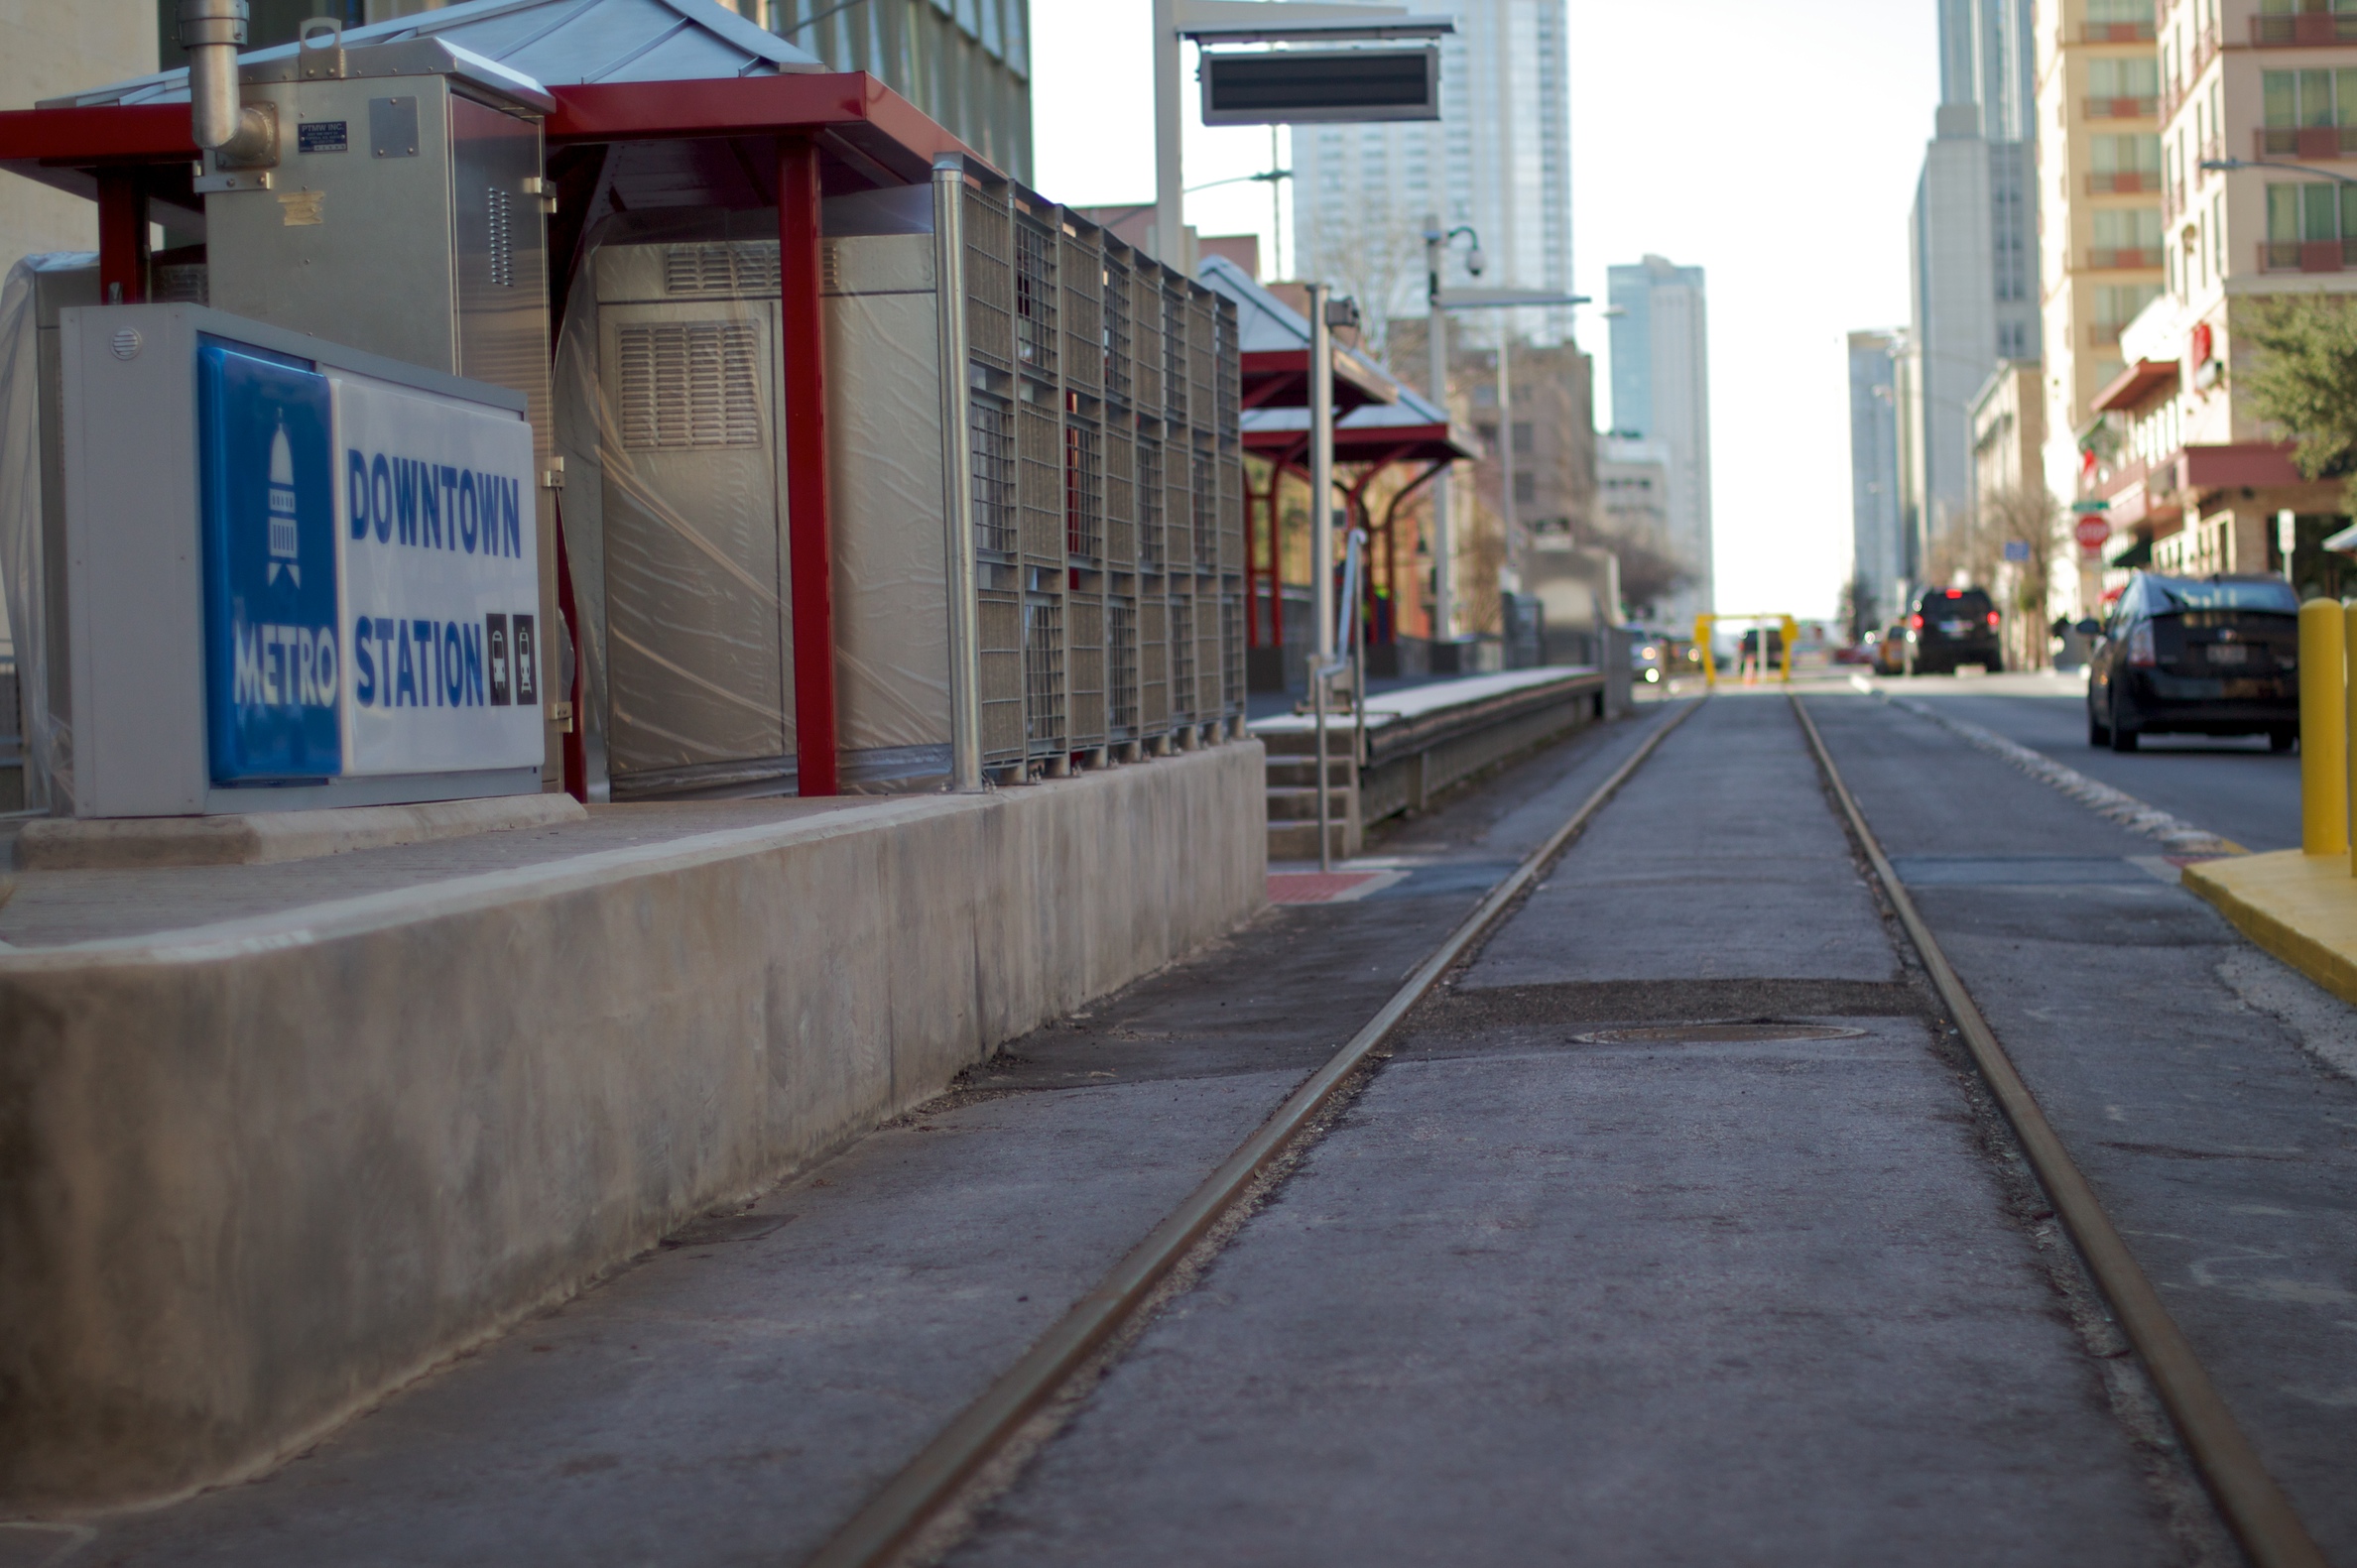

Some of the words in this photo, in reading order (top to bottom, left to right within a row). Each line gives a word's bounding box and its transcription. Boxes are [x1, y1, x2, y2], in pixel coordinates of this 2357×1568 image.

[348, 448, 521, 559] DOWNTOWN
[234, 619, 337, 707] METRO
[355, 615, 484, 708] STATION
